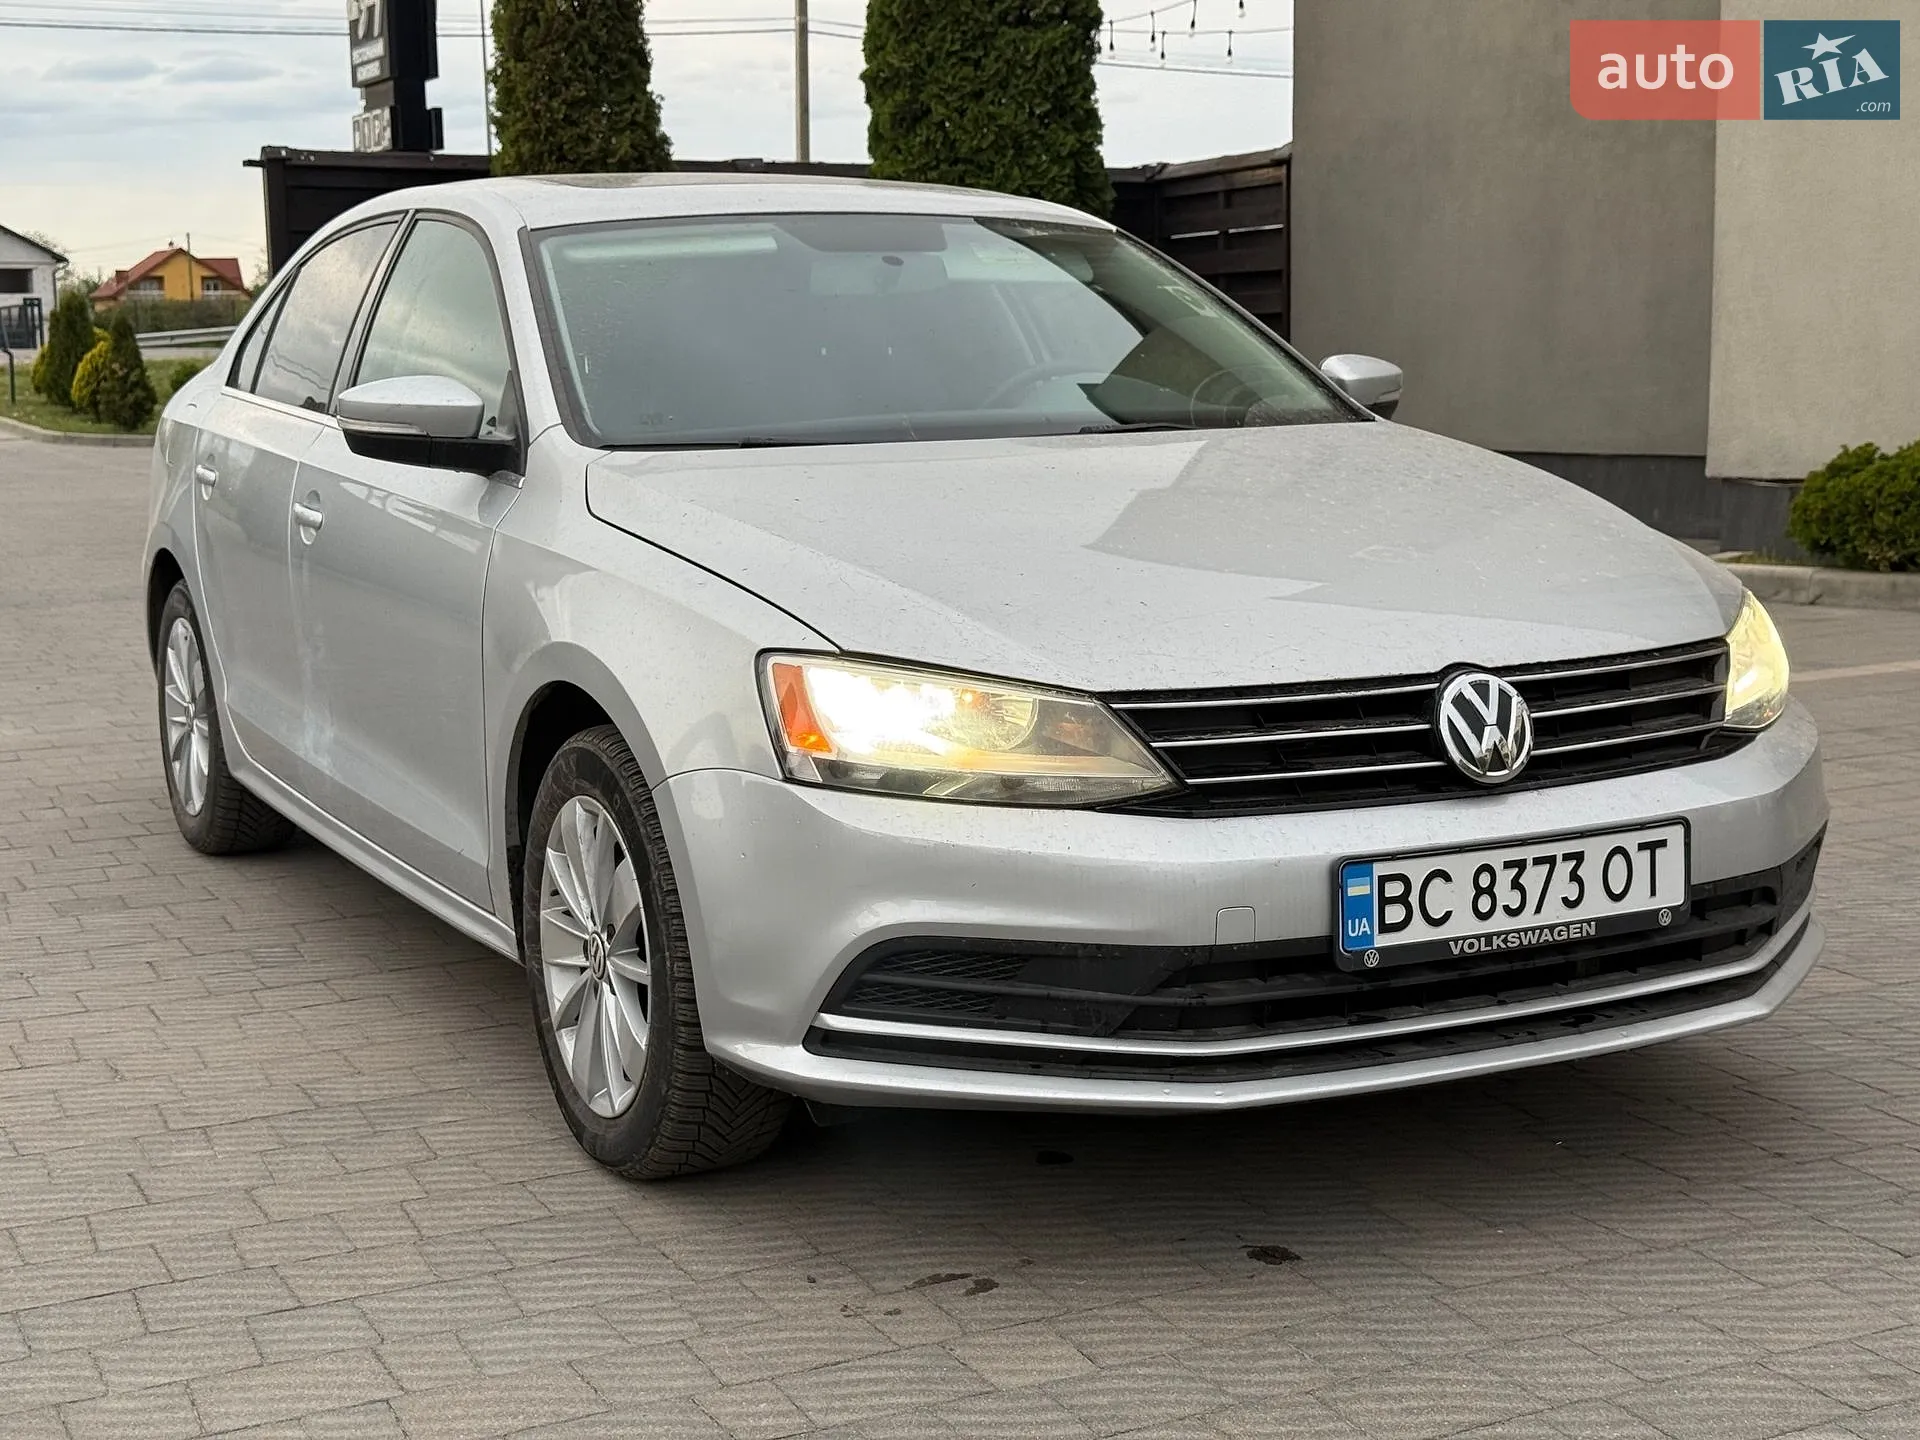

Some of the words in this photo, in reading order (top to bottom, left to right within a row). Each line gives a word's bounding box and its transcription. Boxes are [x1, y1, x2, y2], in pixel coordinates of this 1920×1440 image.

[1376, 868, 1453, 934] BC
[1471, 850, 1586, 921] 8373
[1602, 838, 1668, 902] OT
[1348, 917, 1371, 937] UA
[1449, 921, 1597, 956] VOLKSWAGEN
